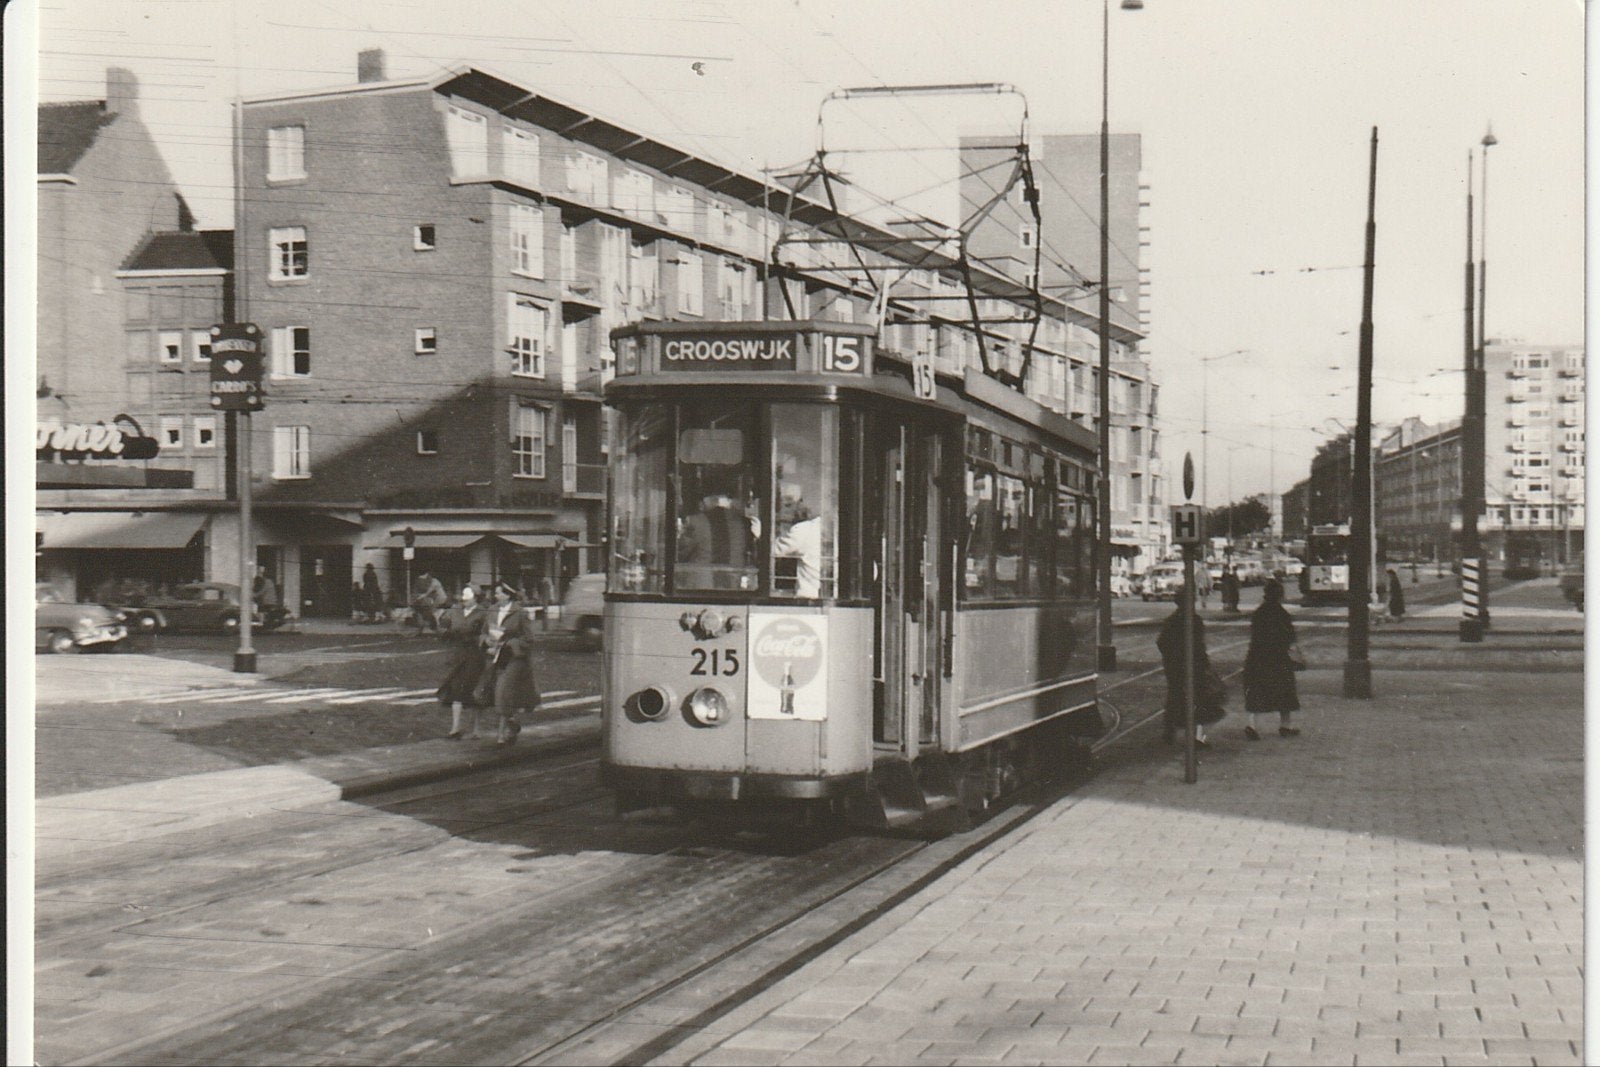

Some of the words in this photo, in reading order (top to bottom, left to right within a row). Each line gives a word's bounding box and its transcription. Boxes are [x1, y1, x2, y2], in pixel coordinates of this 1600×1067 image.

[665, 340, 791, 360] CROOSWIJK
[823, 335, 860, 372] 15
[916, 364, 932, 398] 15
[1175, 511, 1195, 538] H
[689, 647, 740, 677] 215
